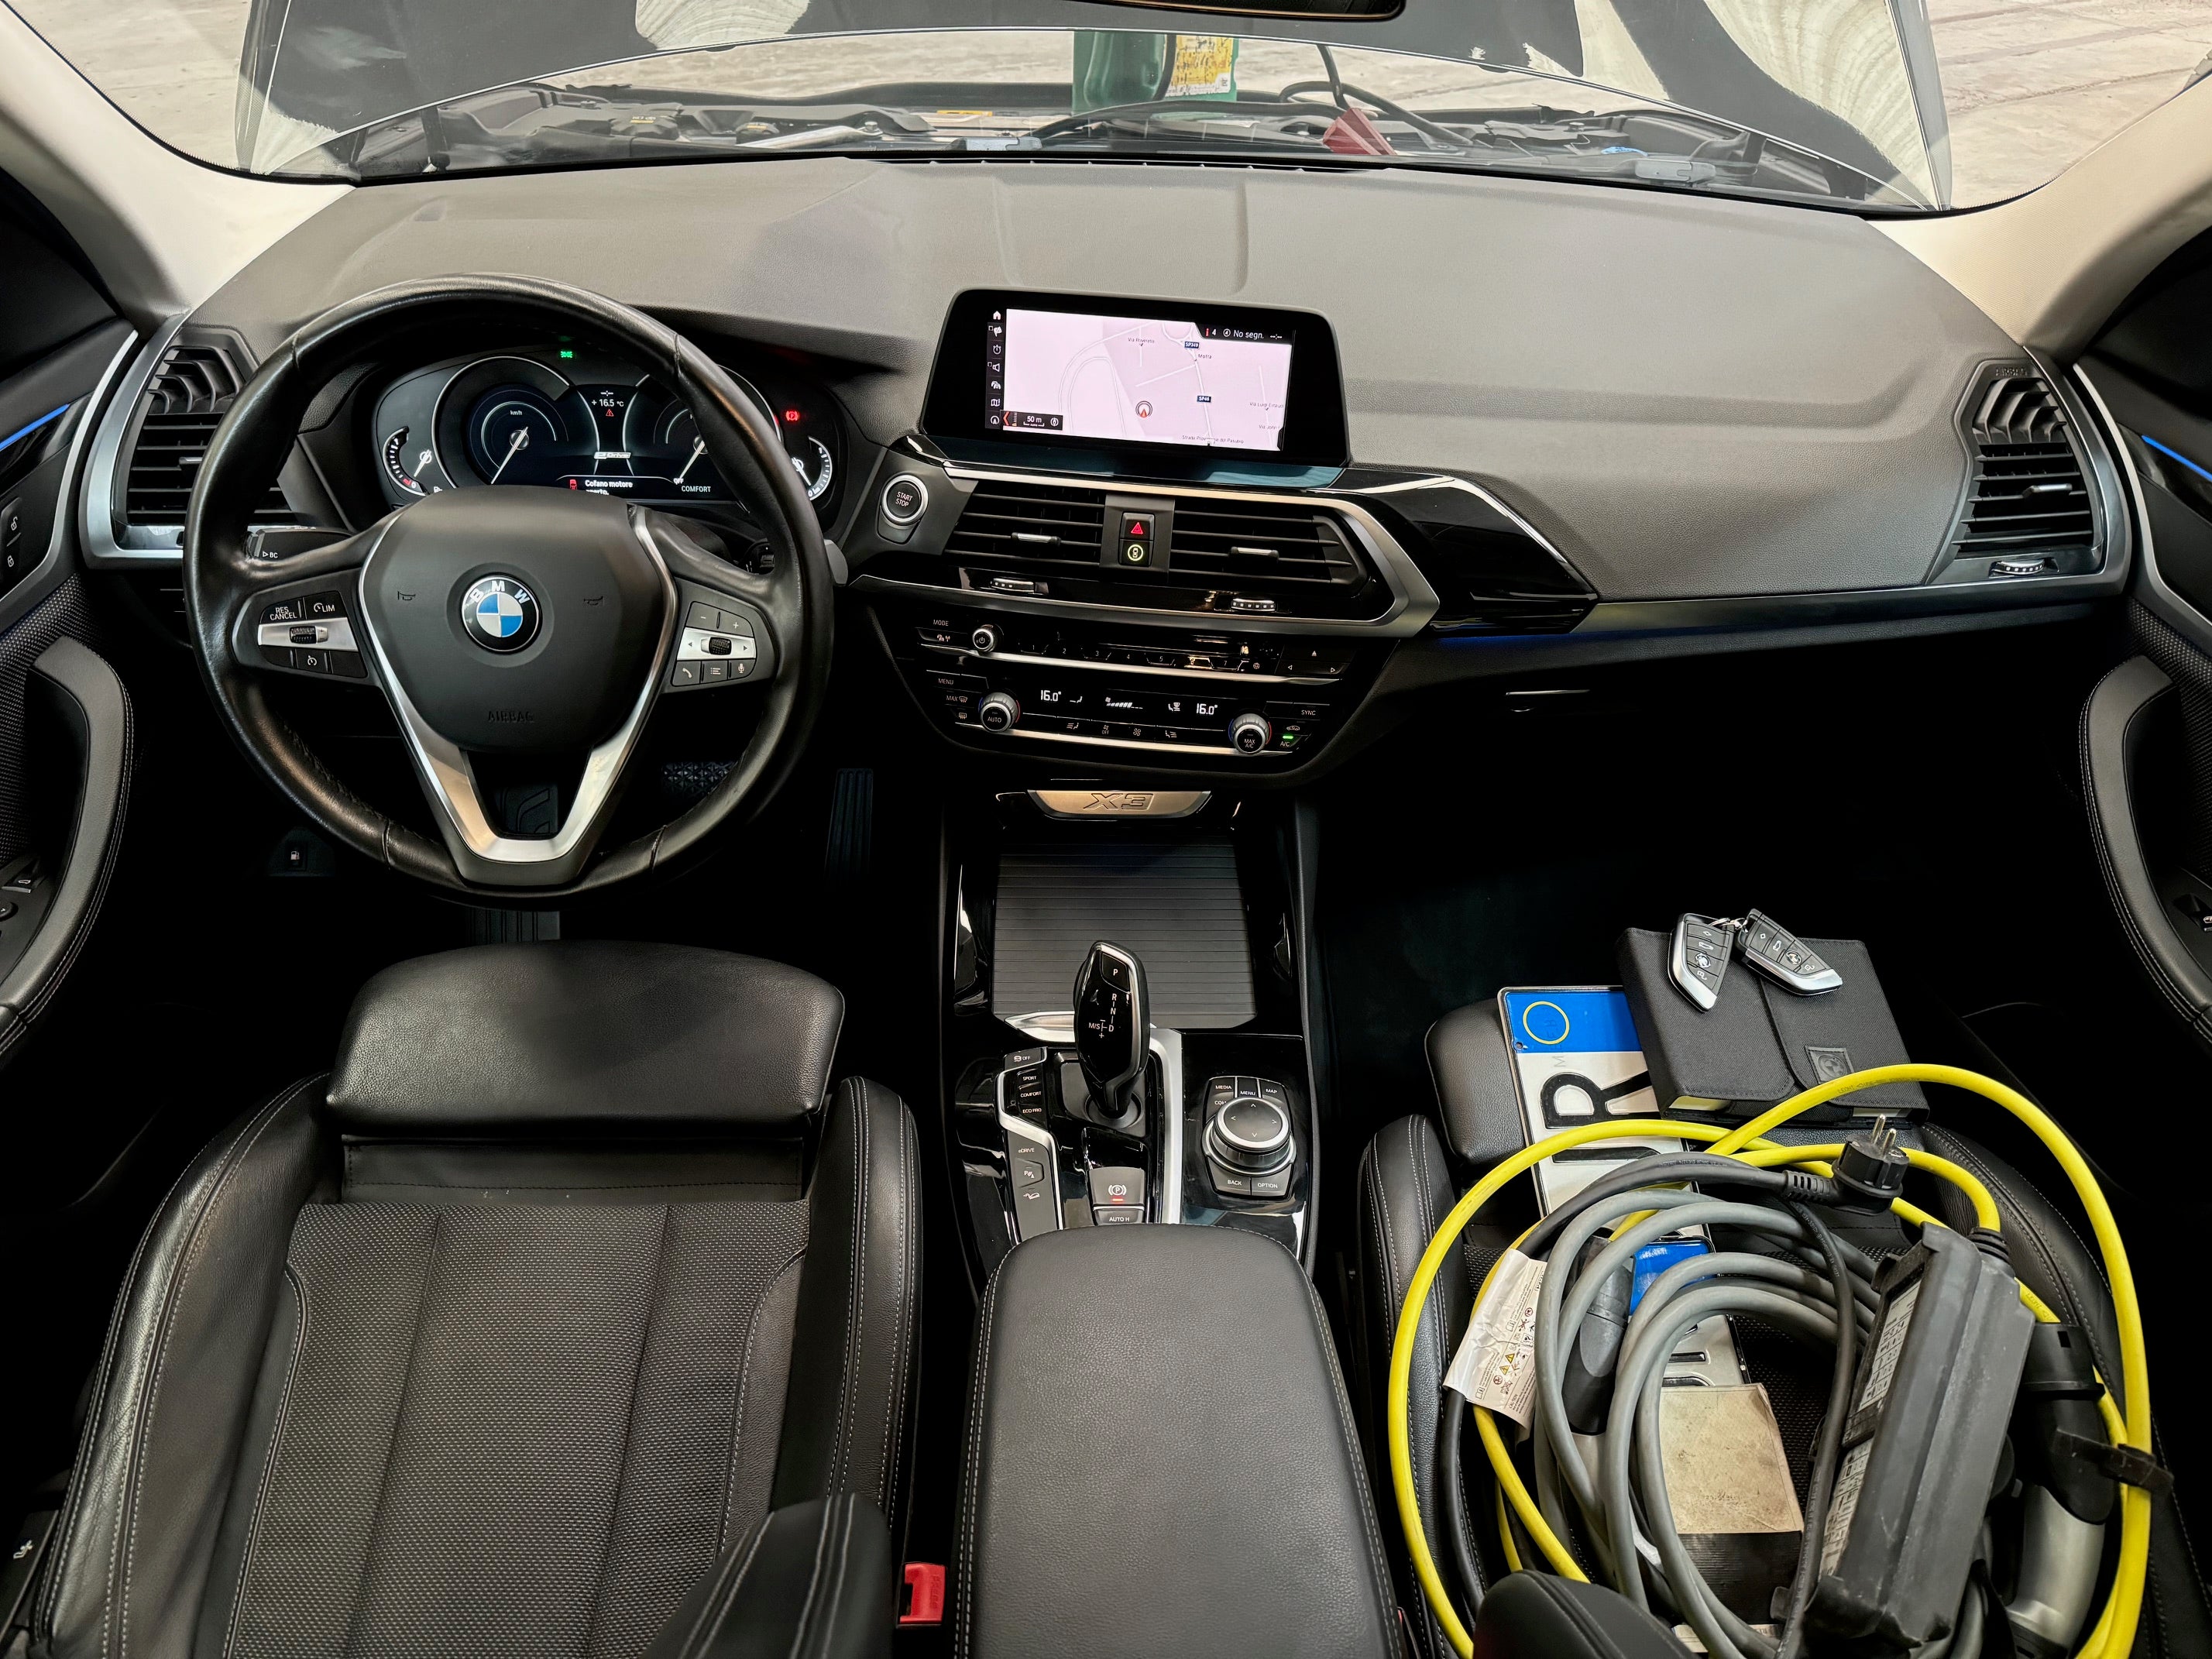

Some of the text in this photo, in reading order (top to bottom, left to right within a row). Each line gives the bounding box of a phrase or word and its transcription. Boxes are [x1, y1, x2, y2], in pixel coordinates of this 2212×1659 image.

[1245, 331, 1264, 340] segn.
[896, 492, 913, 502] START
[895, 499, 909, 507] STOP
[469, 580, 531, 604] BMW
[322, 604, 335, 613] LIM
[270, 612, 297, 620] CANCEL
[1083, 793, 1155, 810] X3
